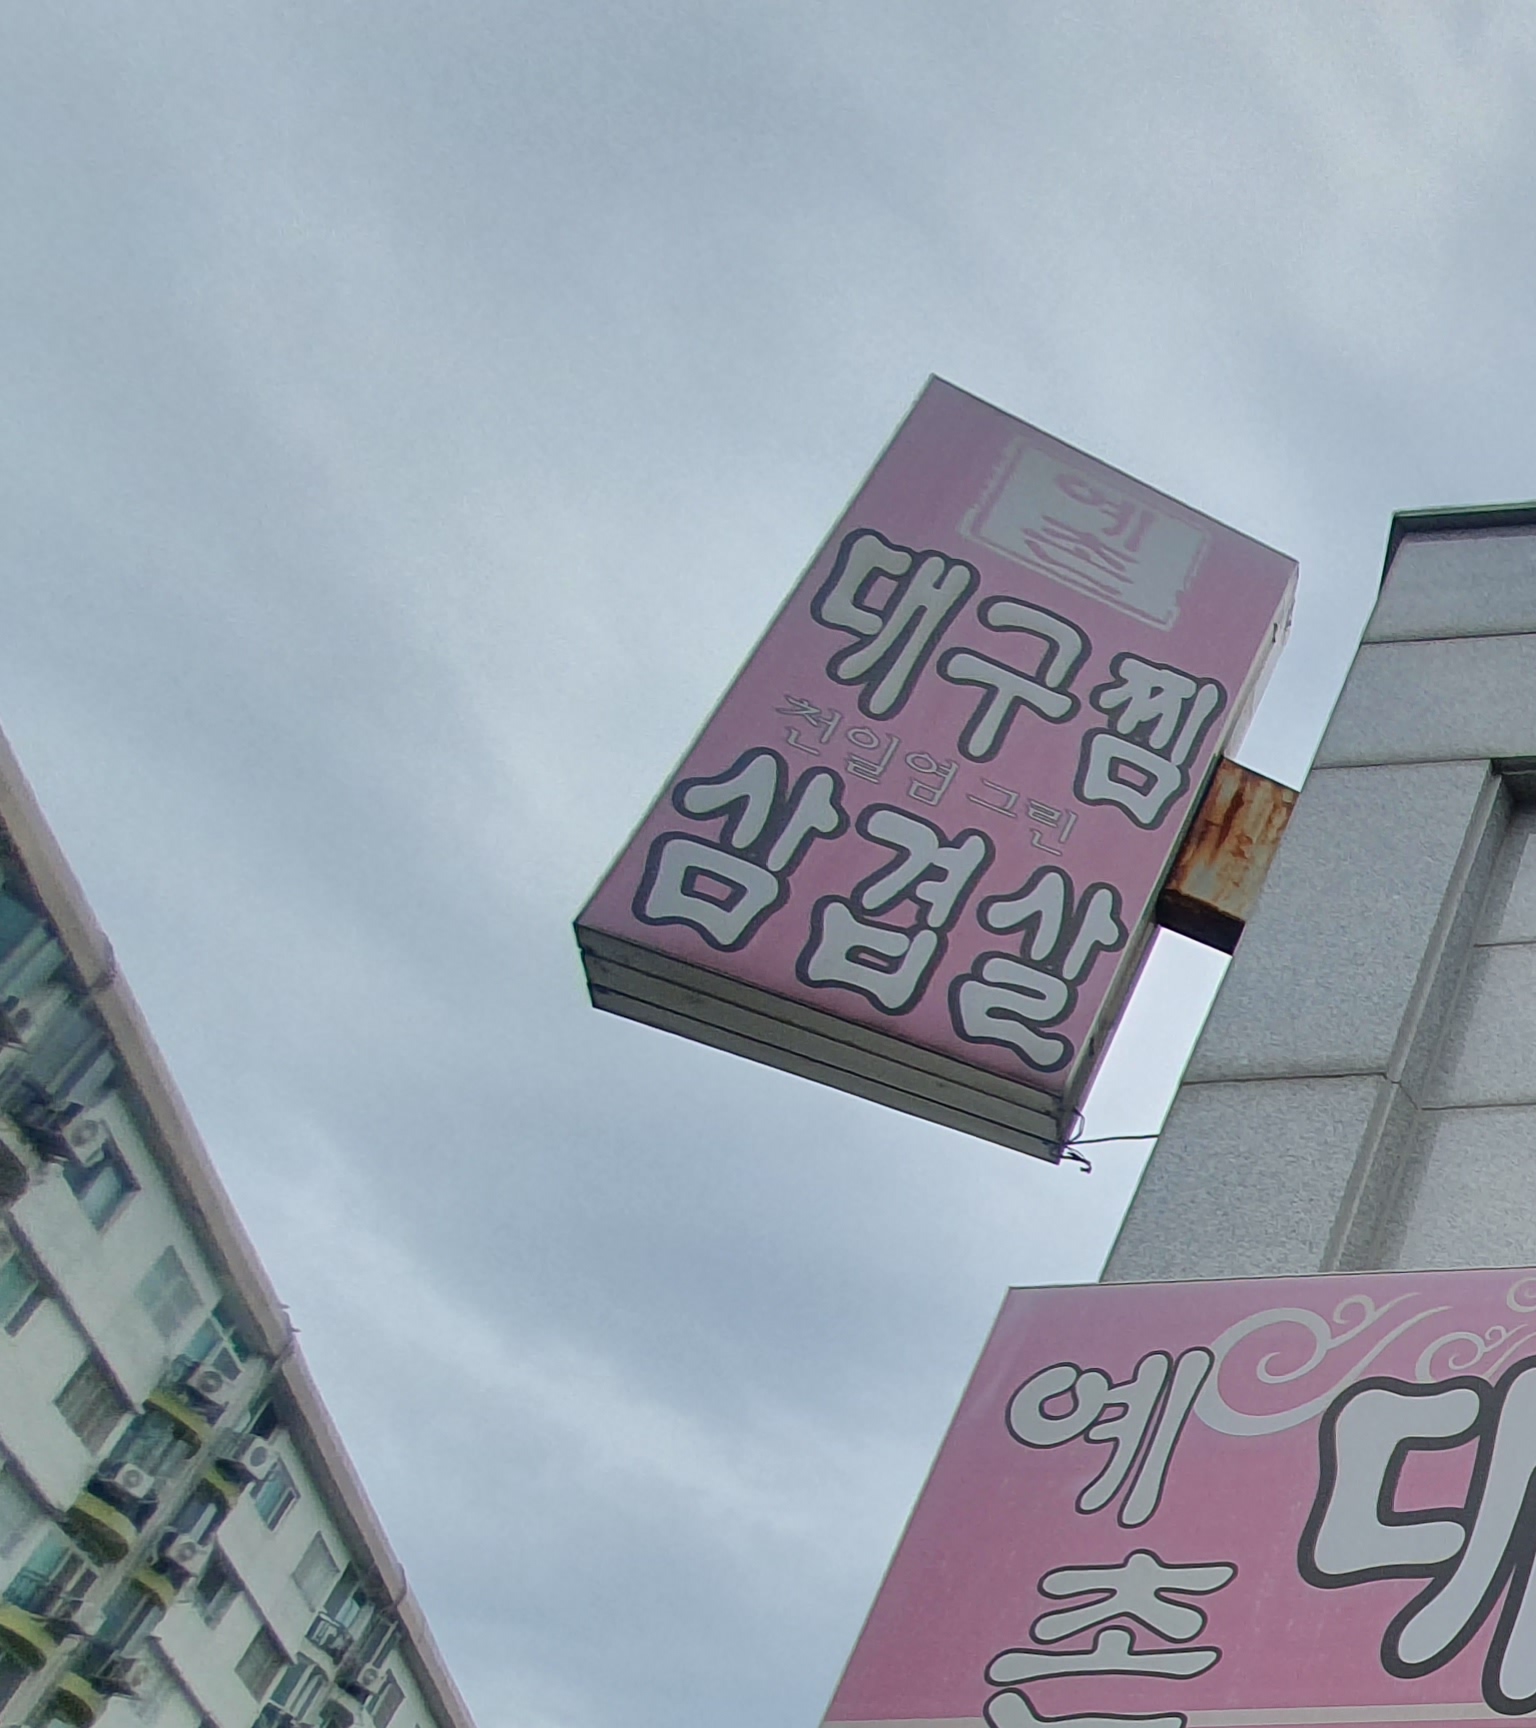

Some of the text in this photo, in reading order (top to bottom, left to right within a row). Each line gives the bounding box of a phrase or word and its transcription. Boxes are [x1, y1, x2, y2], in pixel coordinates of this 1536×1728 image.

[773, 691, 1080, 857] 천일염 그린
[811, 528, 1226, 829] 대구찜
[631, 746, 1129, 1073] 삼겹살
